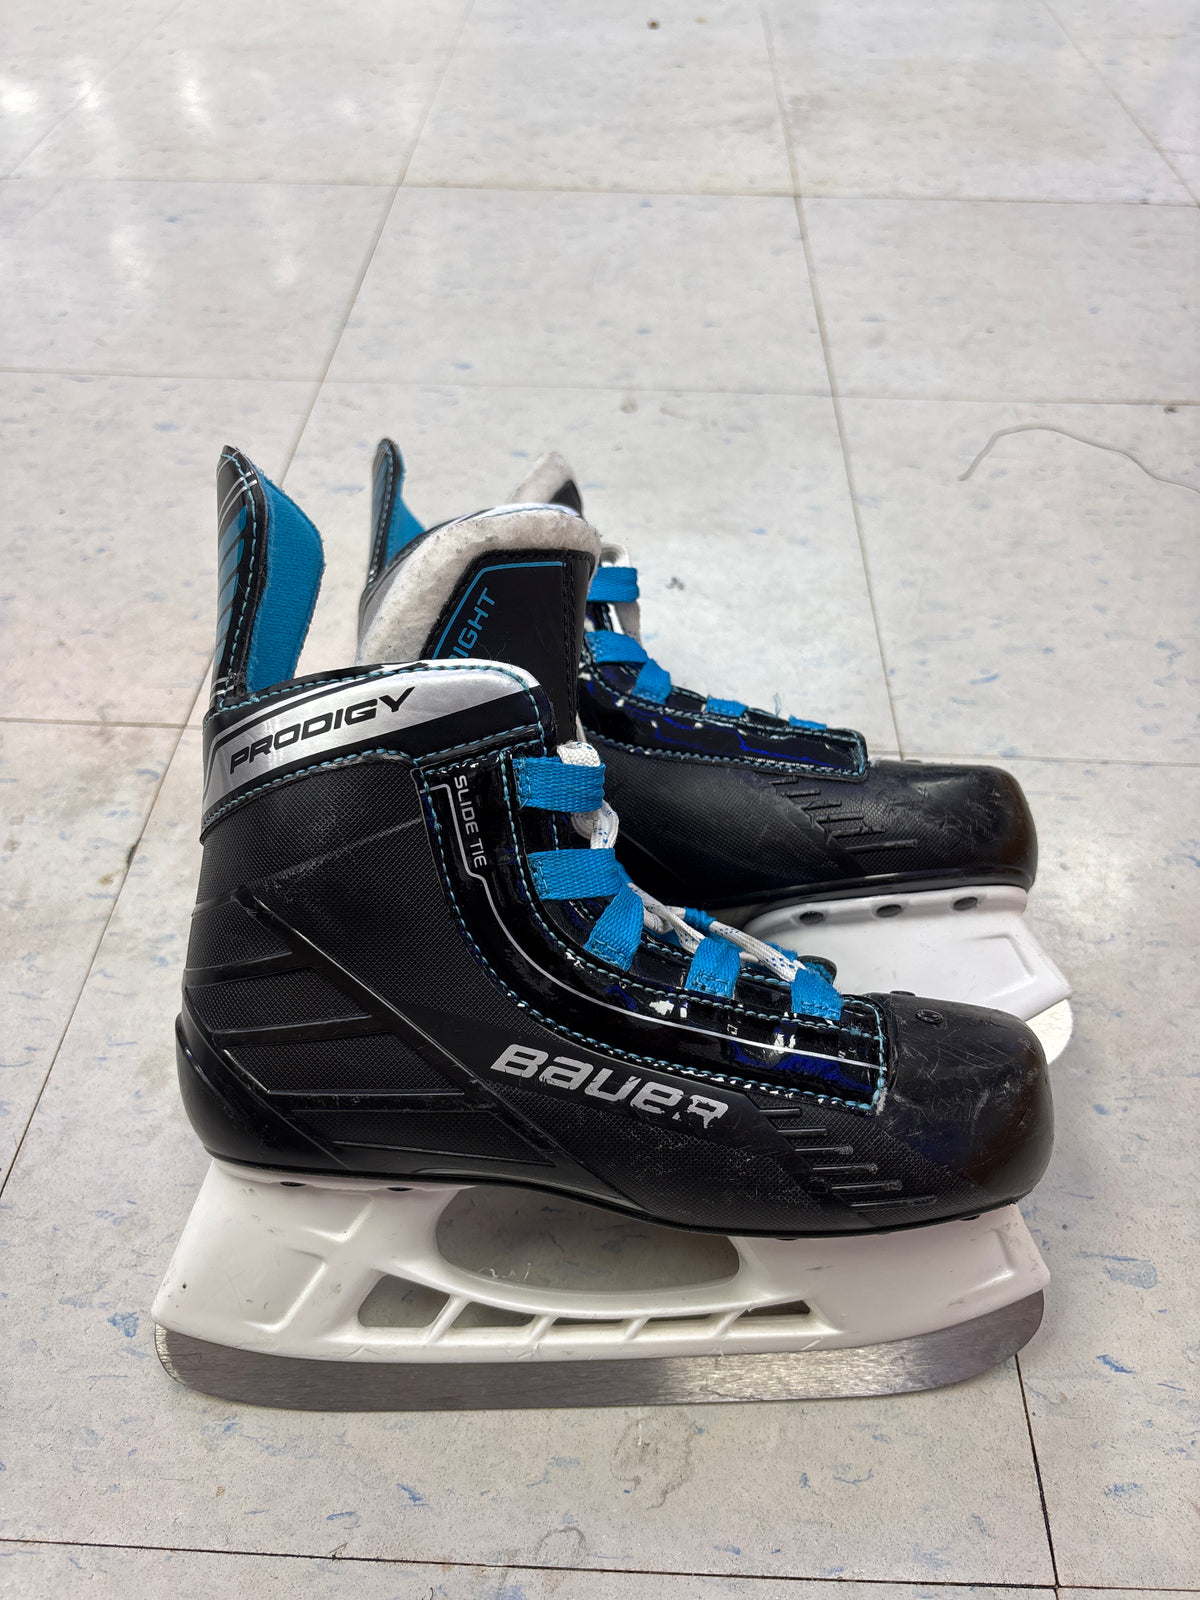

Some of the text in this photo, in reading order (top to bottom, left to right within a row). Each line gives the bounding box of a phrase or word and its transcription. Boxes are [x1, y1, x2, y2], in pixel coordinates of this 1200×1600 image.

[448, 587, 495, 659] IGHT
[230, 686, 415, 774] PRODIGY
[454, 775, 487, 868] SLIDE TIE
